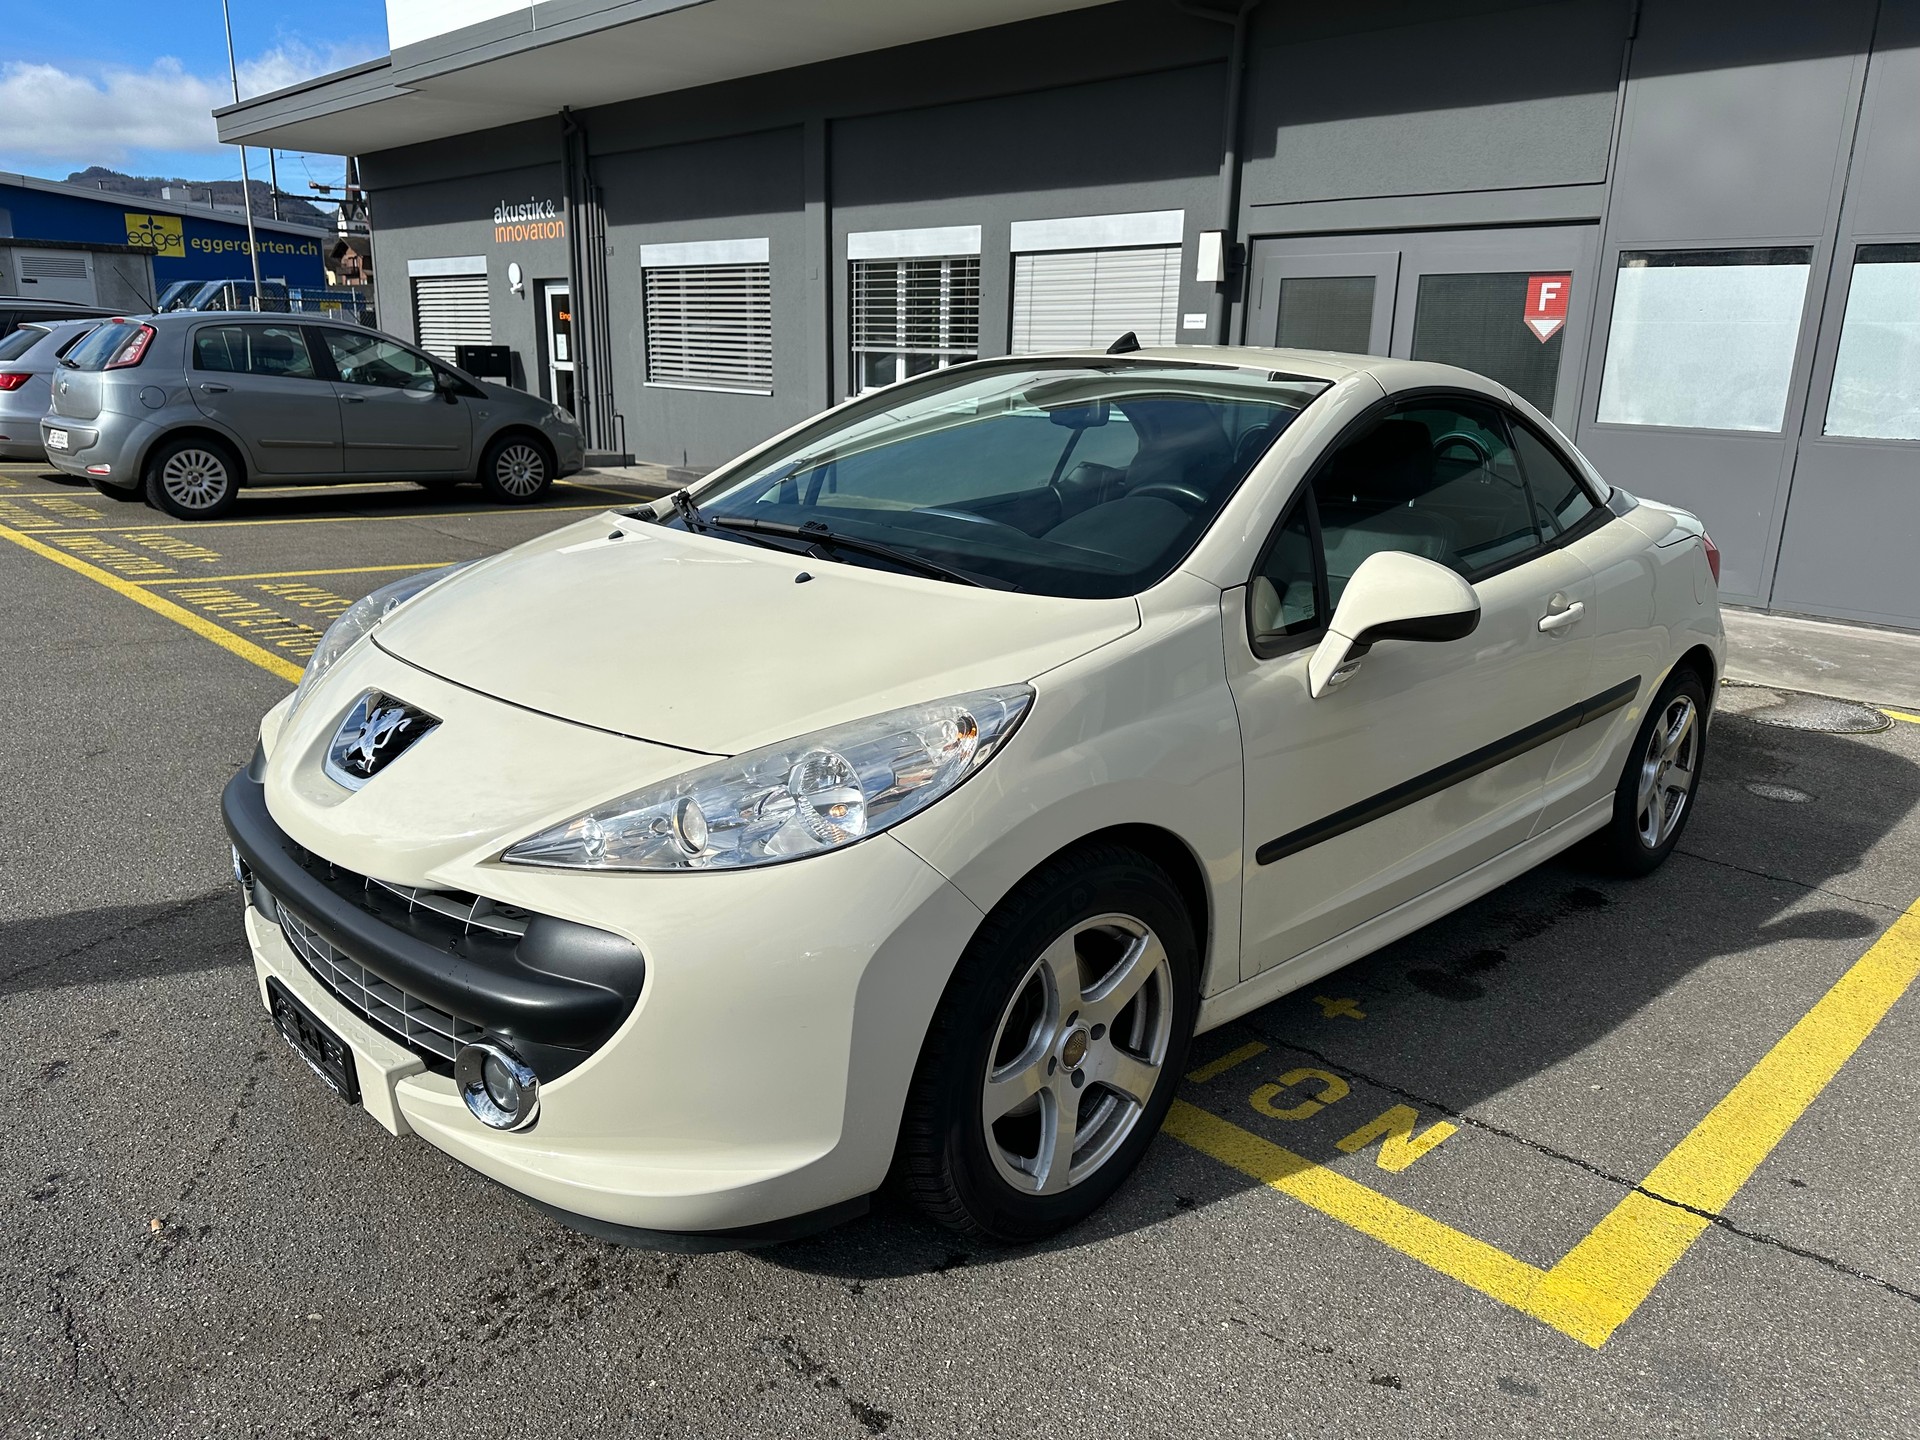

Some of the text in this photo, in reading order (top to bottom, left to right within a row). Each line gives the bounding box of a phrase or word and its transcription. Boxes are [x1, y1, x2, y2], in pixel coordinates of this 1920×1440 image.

[495, 220, 565, 243] innovation
[191, 236, 318, 256] eggergarten.ch
[1538, 282, 1562, 311] F
